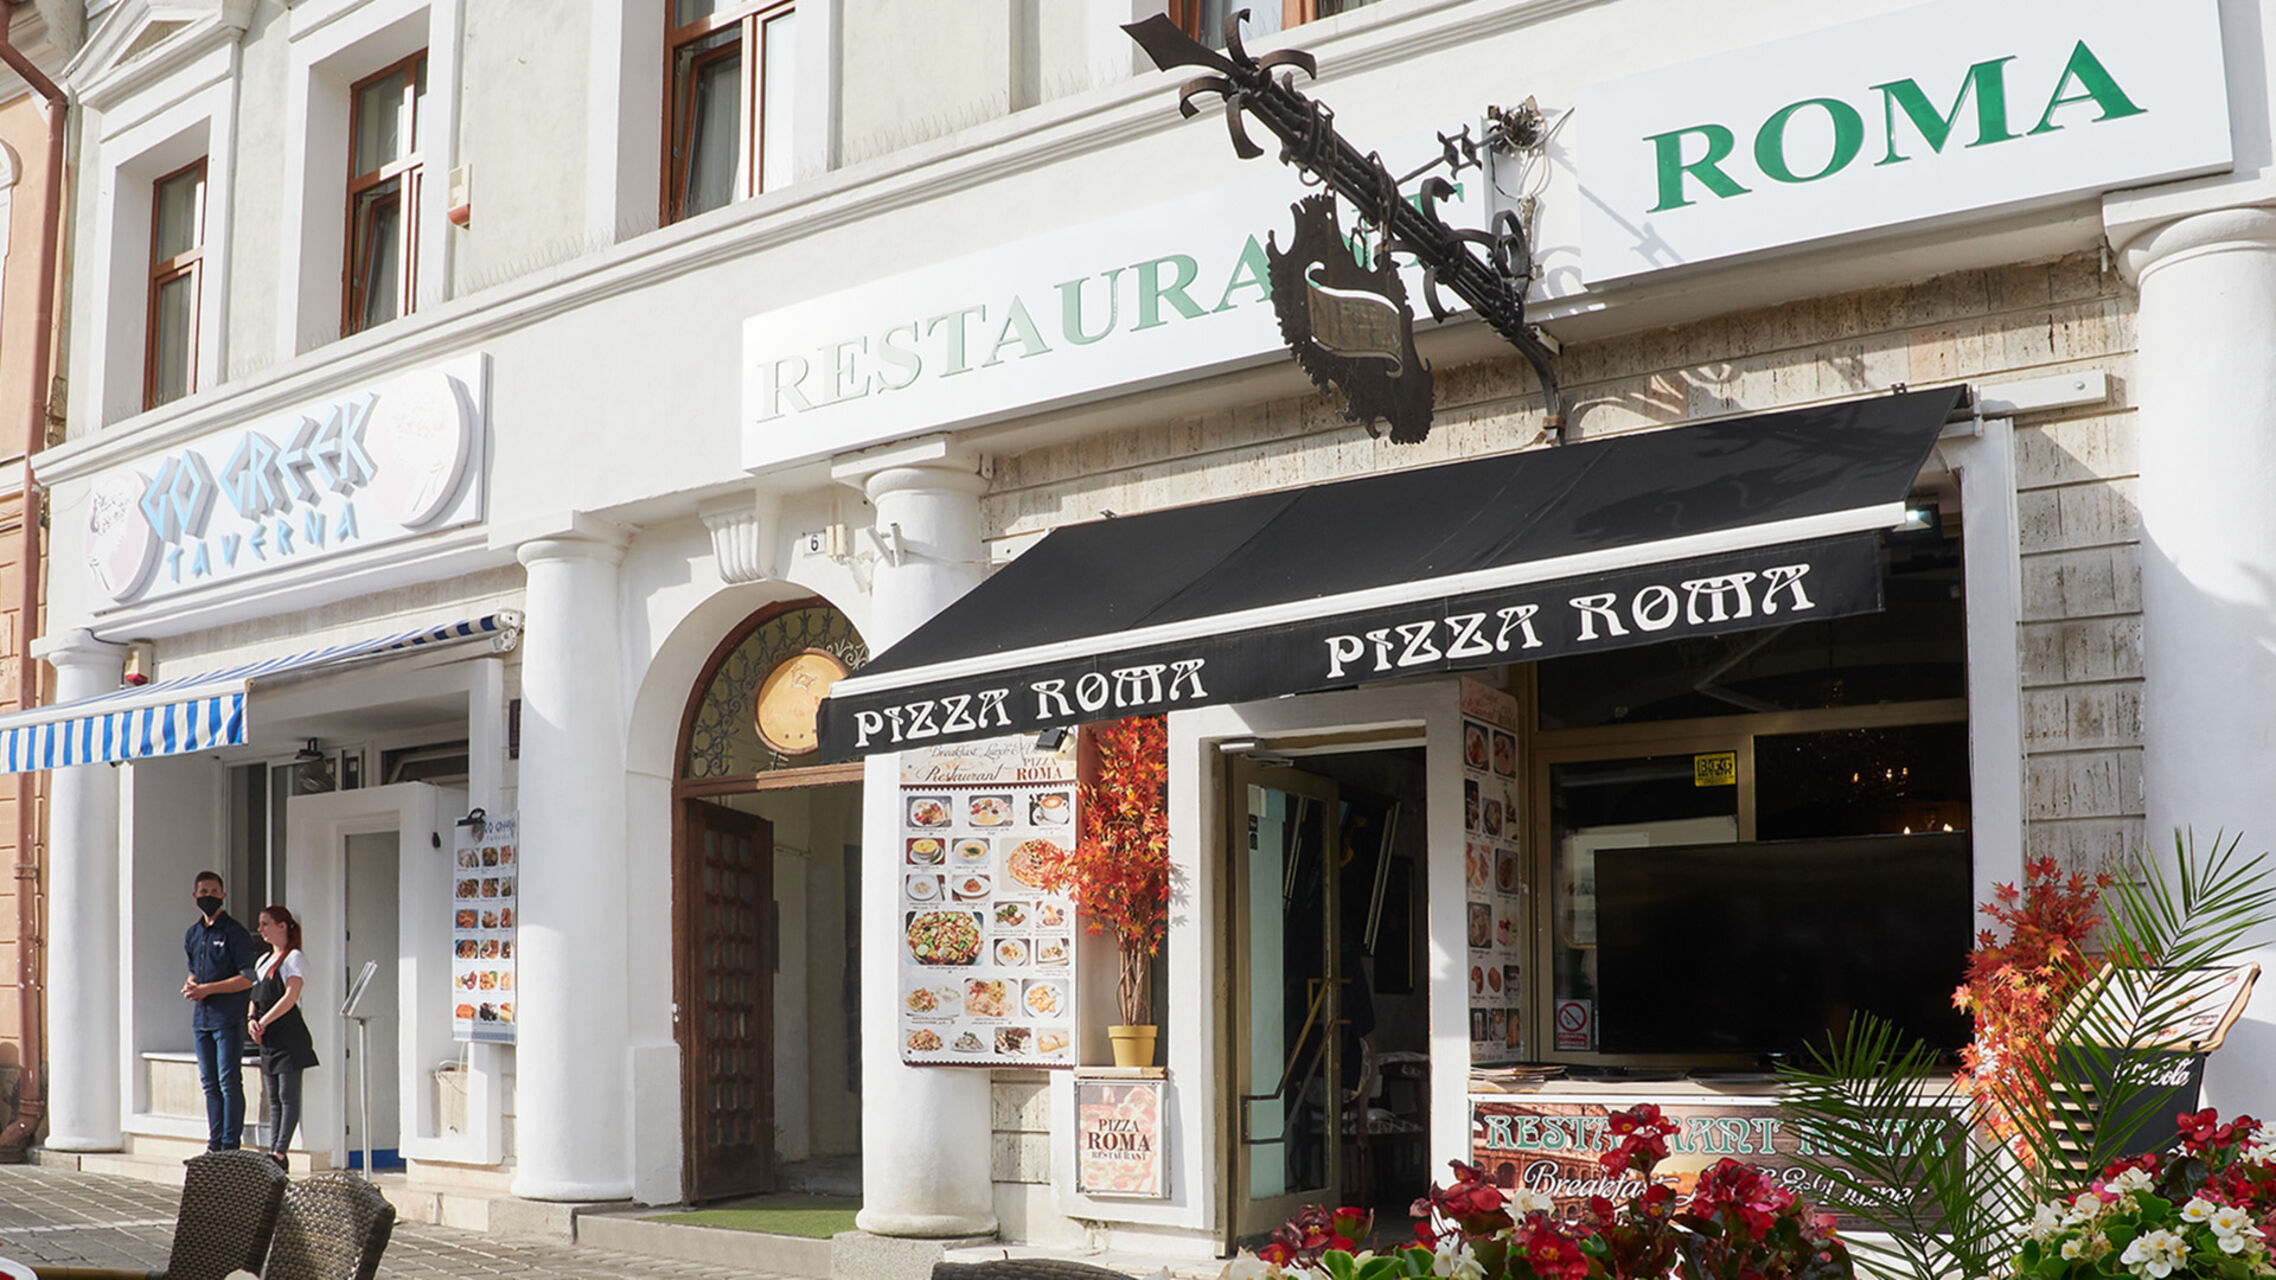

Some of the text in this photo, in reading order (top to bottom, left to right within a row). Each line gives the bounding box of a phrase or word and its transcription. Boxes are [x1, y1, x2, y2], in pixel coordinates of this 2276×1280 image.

[756, 39, 2149, 423] RESTAURA ROMA
[139, 392, 380, 545] GO GREEK
[167, 501, 359, 583] TAVERNA
[810, 534, 819, 552] 6
[1324, 563, 1815, 679] PIZZA ROMA
[854, 658, 1208, 748] PIZZA ROMA
[1016, 767, 1063, 781] ROMA
[1088, 1131, 1152, 1152] ROMA
[1098, 1119, 1140, 1132] PIZZA
[1484, 1115, 1784, 1155] RESTAANT
[1091, 1151, 1147, 1161] RESTAURANT
